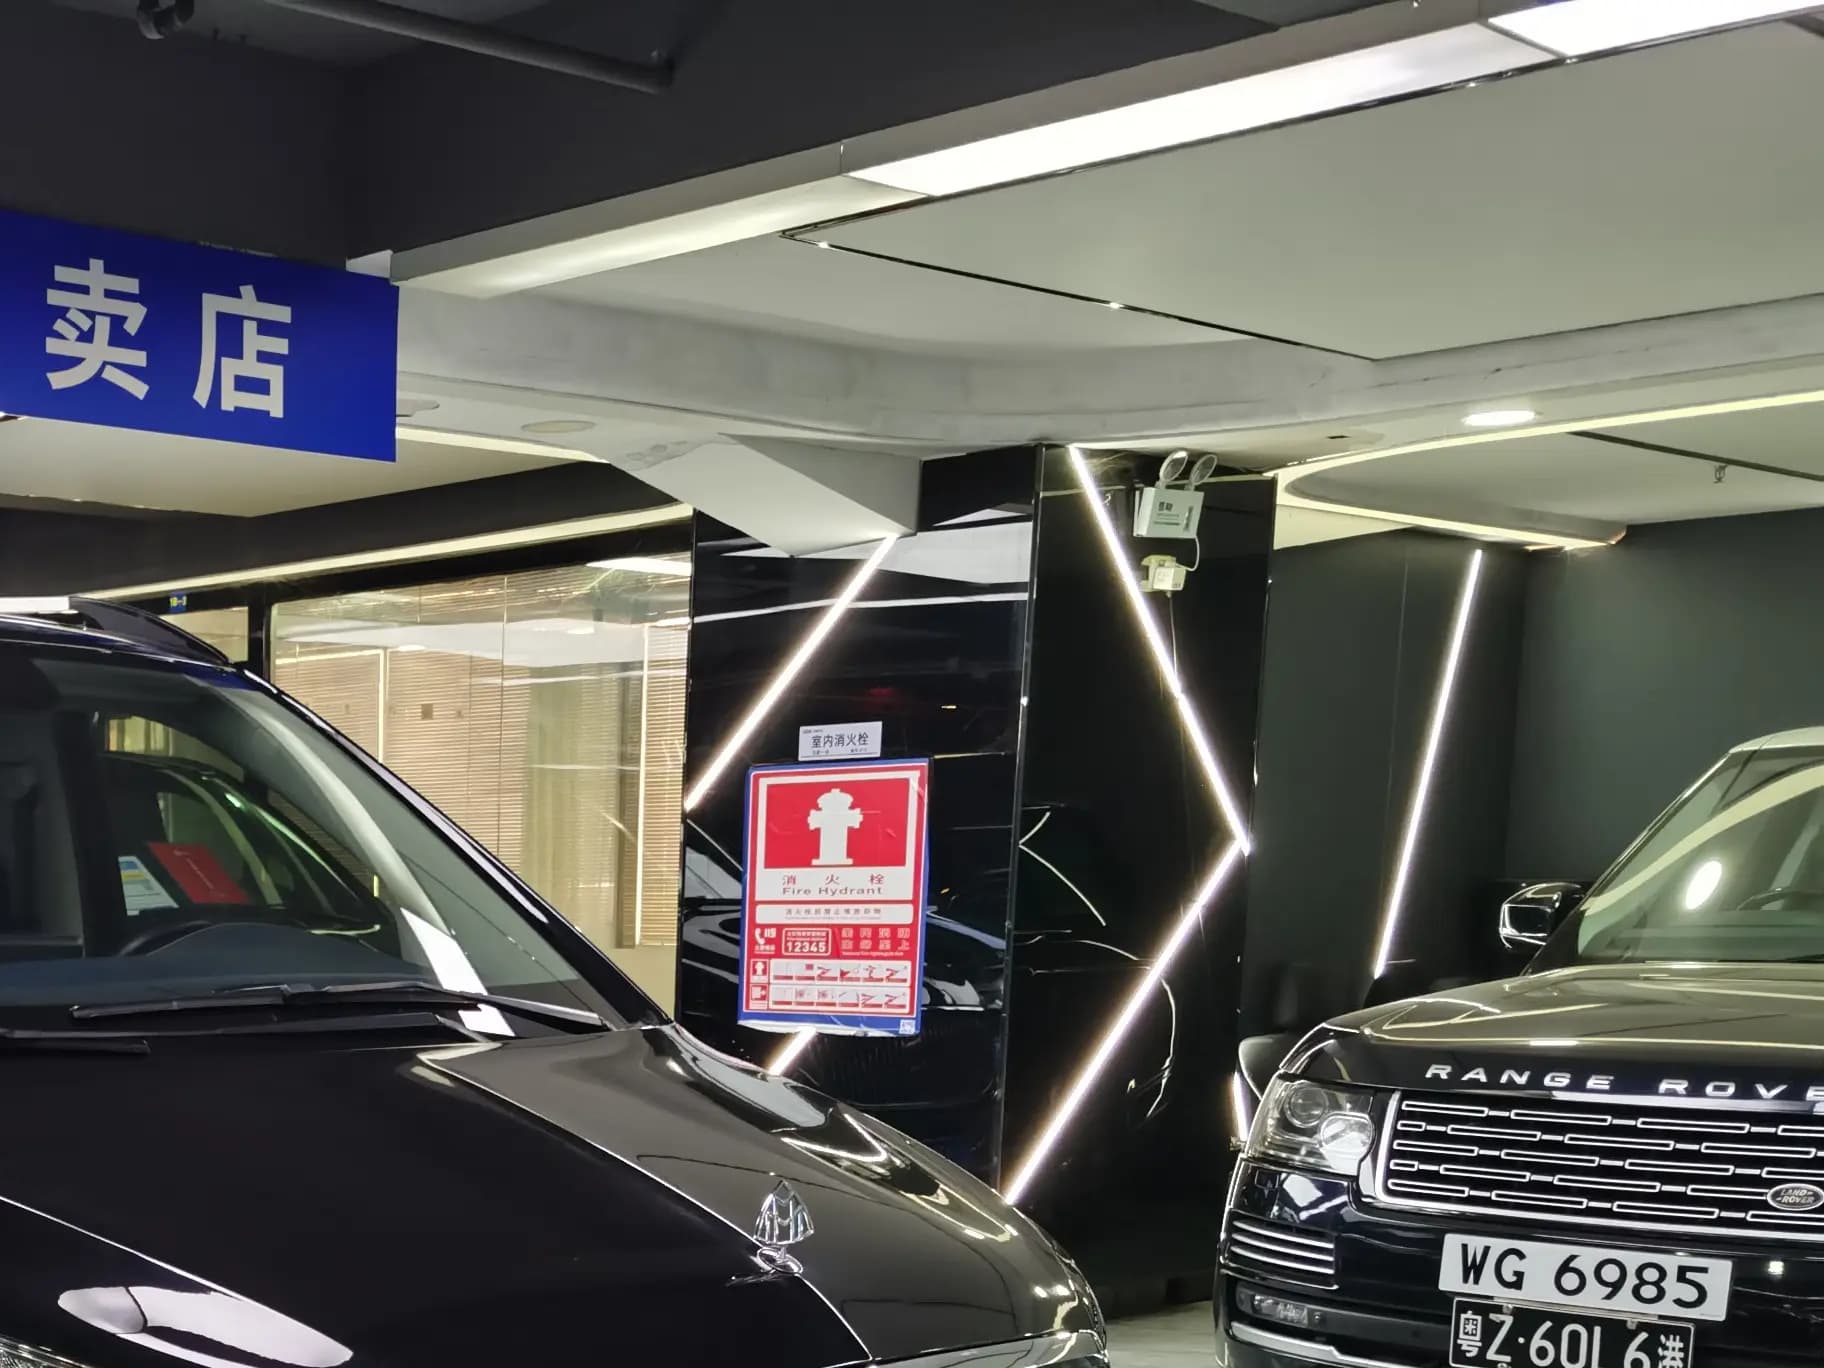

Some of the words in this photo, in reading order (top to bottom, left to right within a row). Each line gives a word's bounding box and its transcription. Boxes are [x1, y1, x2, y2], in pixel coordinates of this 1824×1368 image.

[811, 732, 869, 749] 室内消火栓
[782, 873, 885, 886] 消火栓
[782, 887, 812, 896] Fire
[818, 885, 883, 897] Hydrant
[786, 941, 826, 953] 12345
[1425, 1064, 1615, 1092] RANGE
[1460, 1242, 1527, 1291] WG
[1553, 1254, 1710, 1310] 6985
